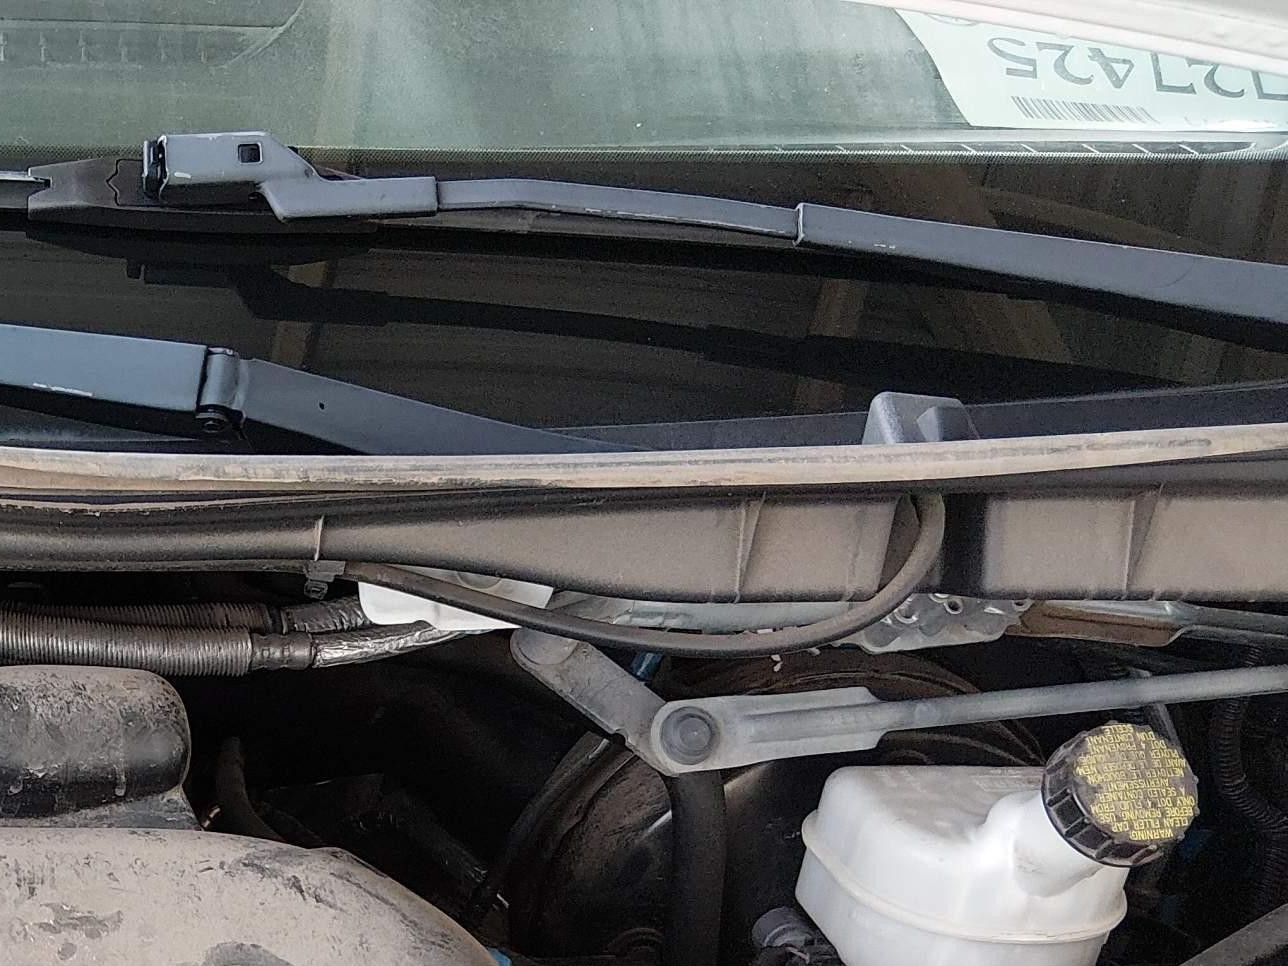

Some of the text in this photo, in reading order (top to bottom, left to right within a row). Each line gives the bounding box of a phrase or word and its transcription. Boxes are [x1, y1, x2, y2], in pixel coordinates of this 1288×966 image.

[1151, 749, 1178, 758] PLOYER
[1165, 758, 1185, 767] AVANT
[1146, 768, 1184, 778] NETTOYER
[1148, 787, 1176, 797] SEALED
[1179, 787, 1185, 796] A
[1120, 800, 1142, 810] FLUID
[1158, 798, 1172, 807] DOT
[1177, 796, 1195, 806] ONLY
[1090, 803, 1115, 814] FROM
[1165, 807, 1193, 816] BEFORE
[1098, 813, 1116, 823] USE
[1112, 817, 1188, 832] CLEAN FILLER CAP
